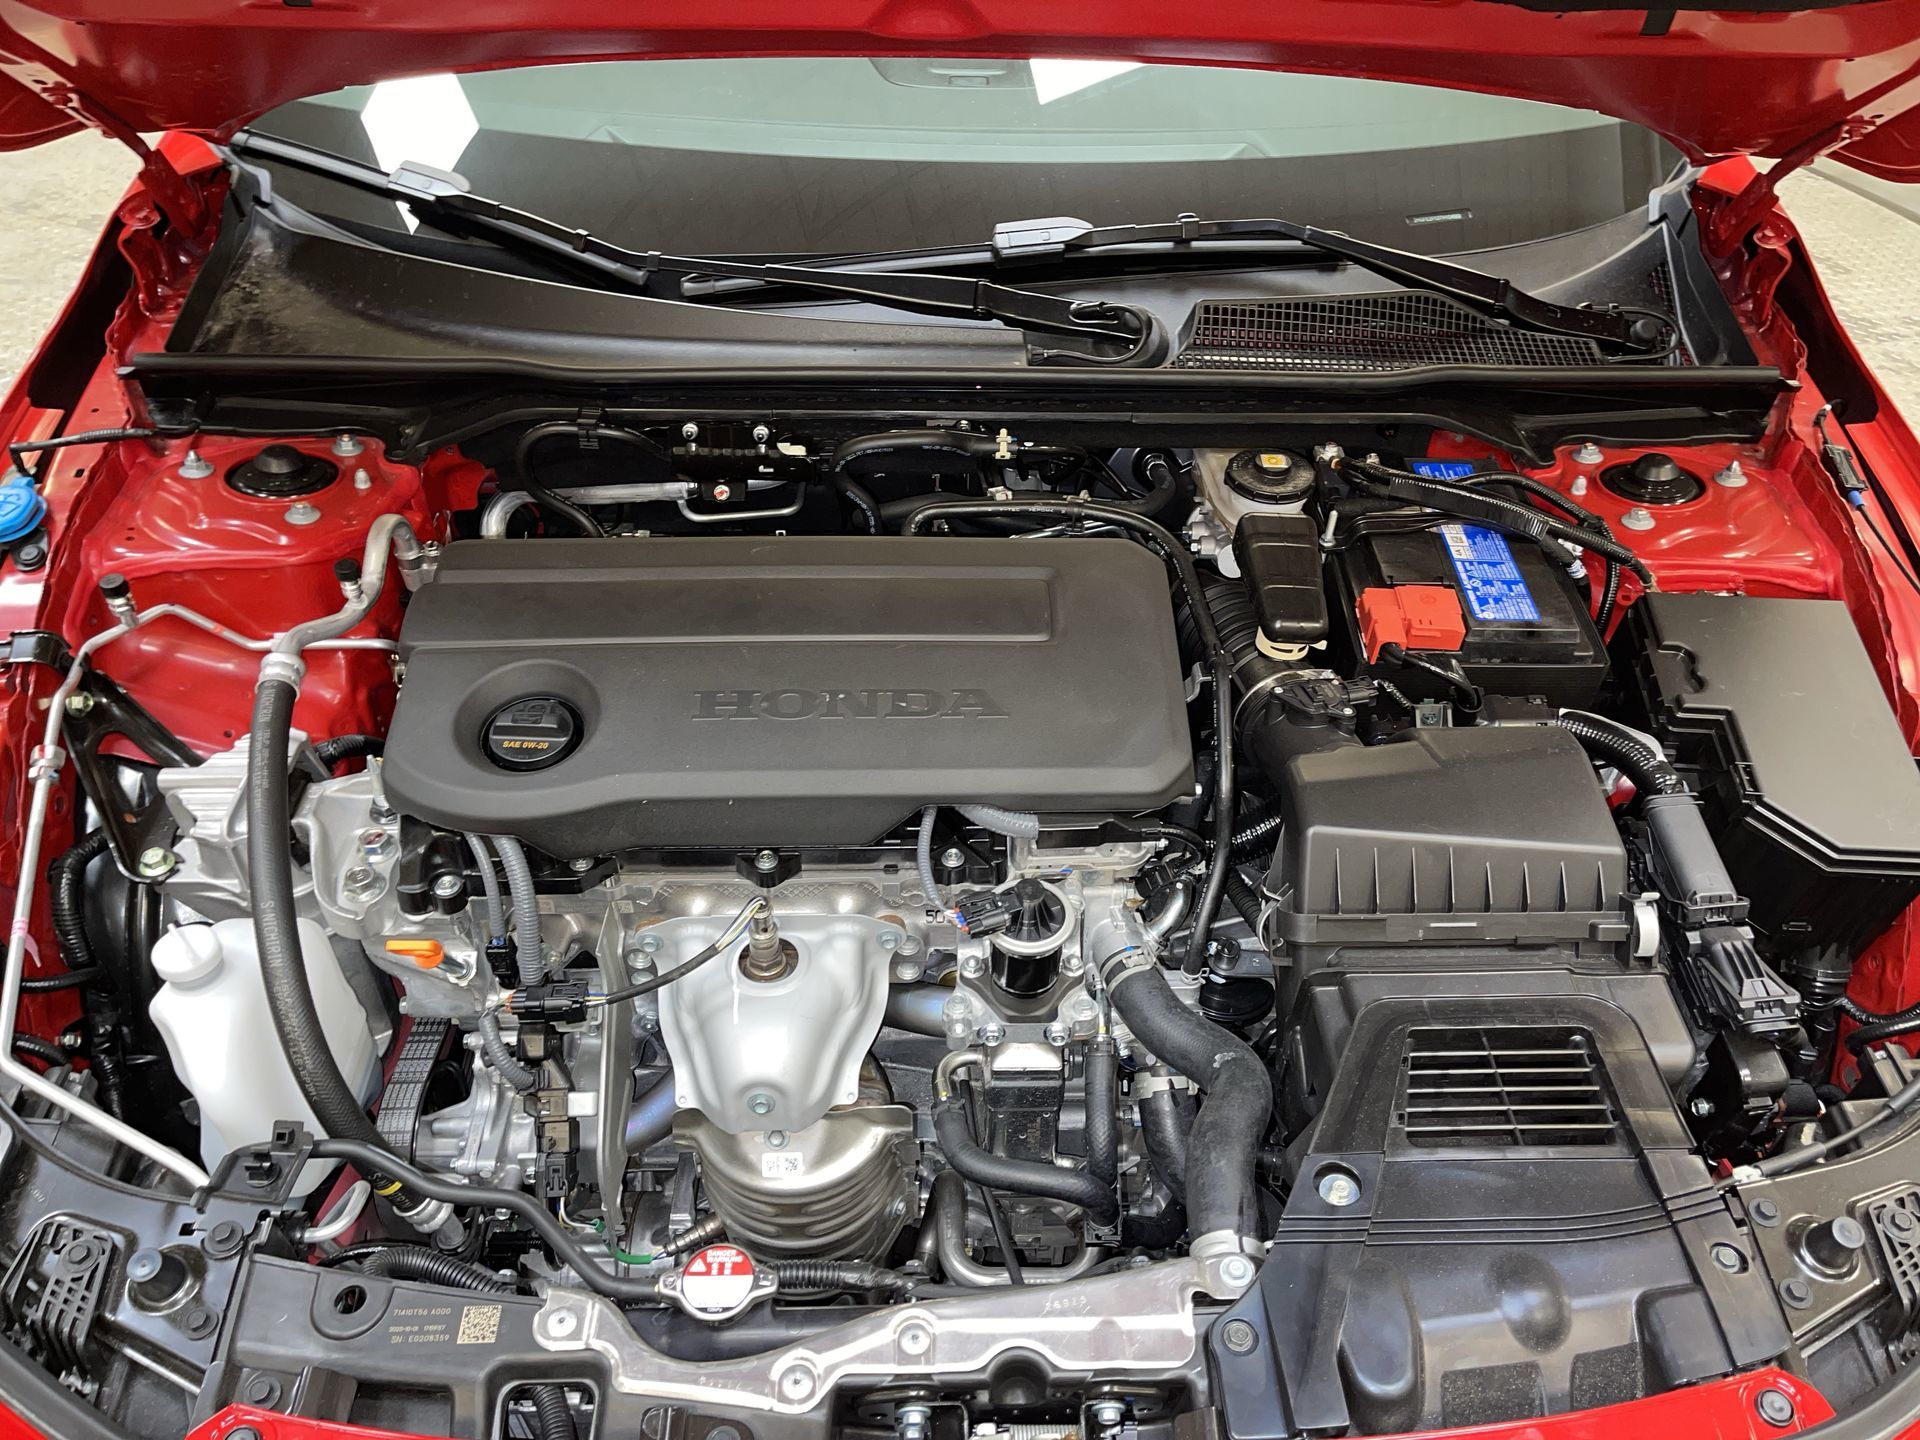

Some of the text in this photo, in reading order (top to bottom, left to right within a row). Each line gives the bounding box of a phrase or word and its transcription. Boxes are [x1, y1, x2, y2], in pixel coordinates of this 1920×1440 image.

[691, 688, 1010, 721] HONDA
[502, 740, 549, 750] SAE 0W-20
[430, 1307, 452, 1316] A000
